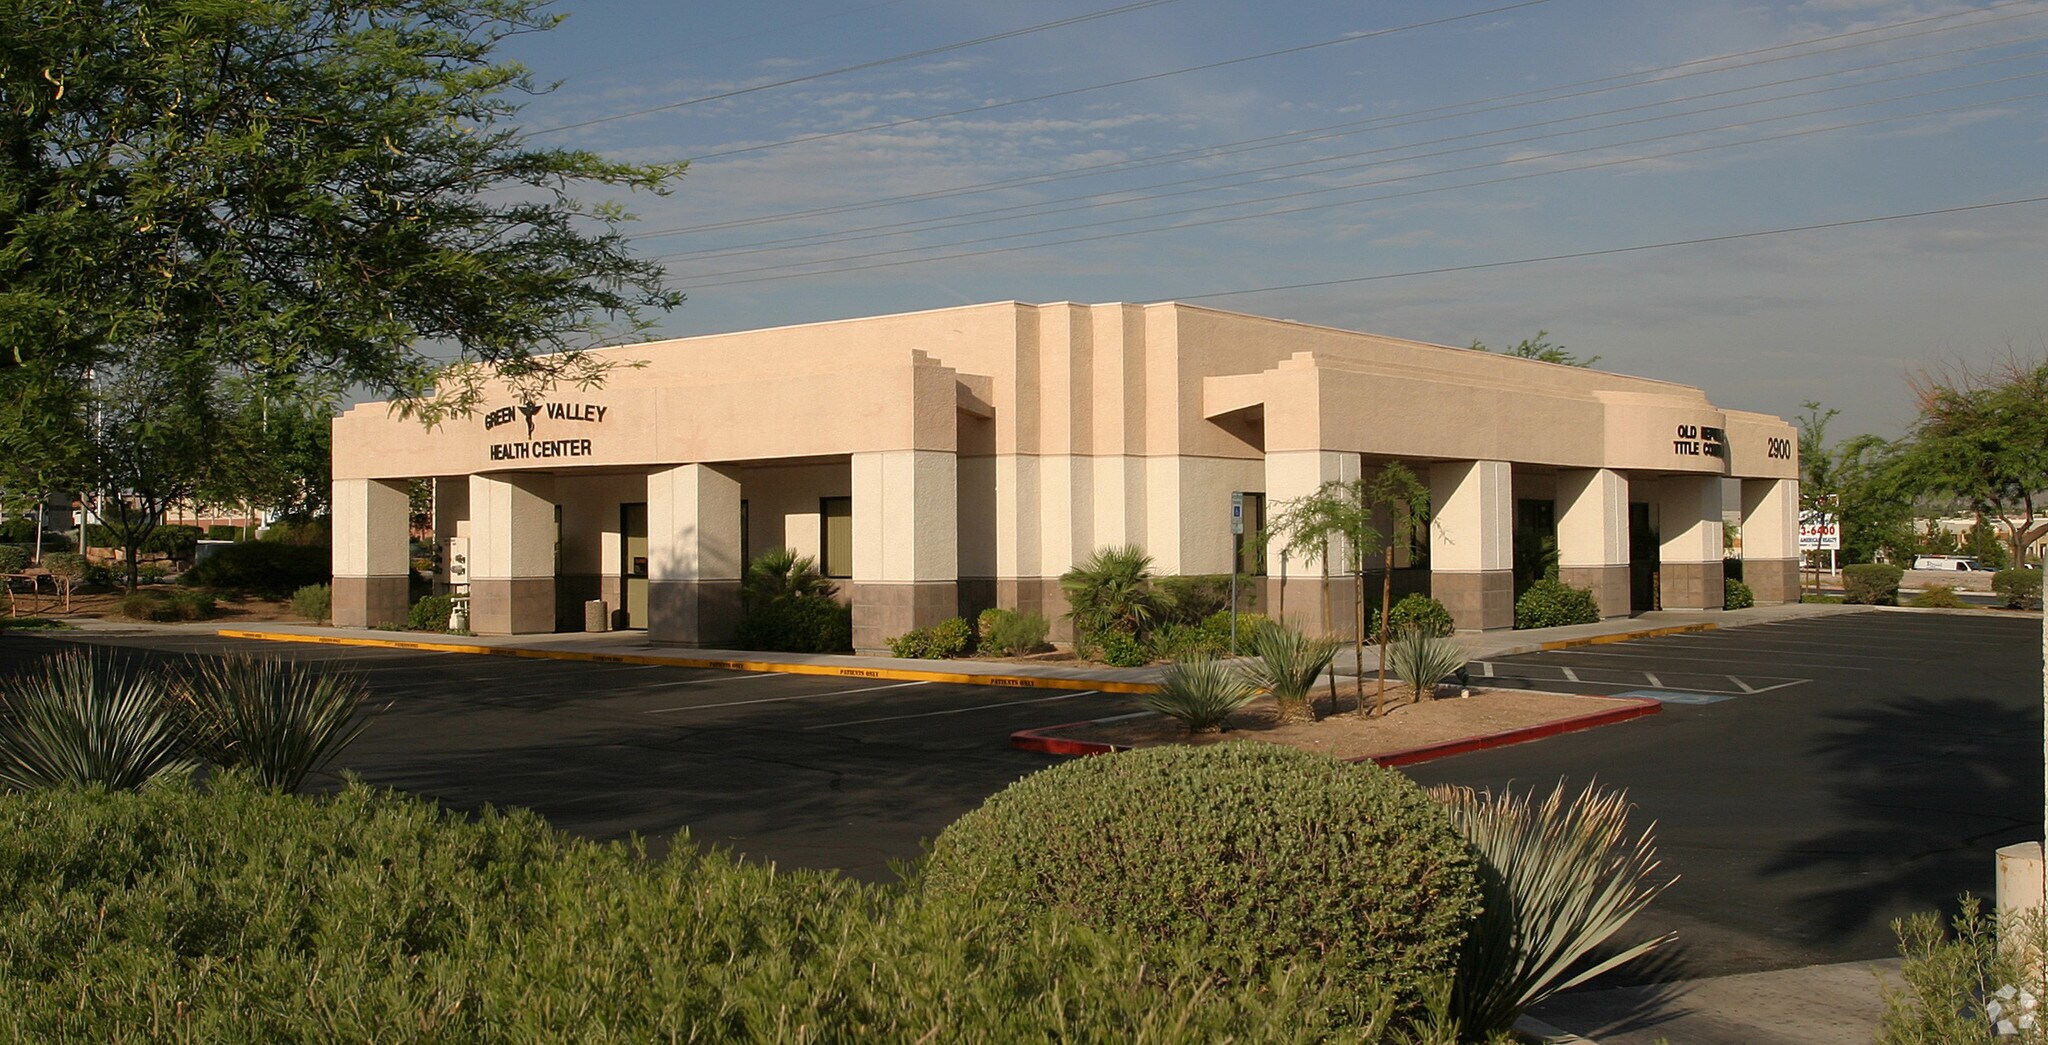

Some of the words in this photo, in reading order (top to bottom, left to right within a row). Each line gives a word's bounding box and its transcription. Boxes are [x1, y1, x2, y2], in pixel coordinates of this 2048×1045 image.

[484, 405, 516, 431] GREEN
[546, 402, 608, 423] VALLEY
[1677, 424, 1697, 439] OLD
[490, 442, 530, 461] HEALTH
[532, 439, 592, 459] CENTER
[1673, 440, 1700, 456] TITLE
[1767, 437, 1791, 460] 2900
[990, 678, 1019, 686] PATIENTS
